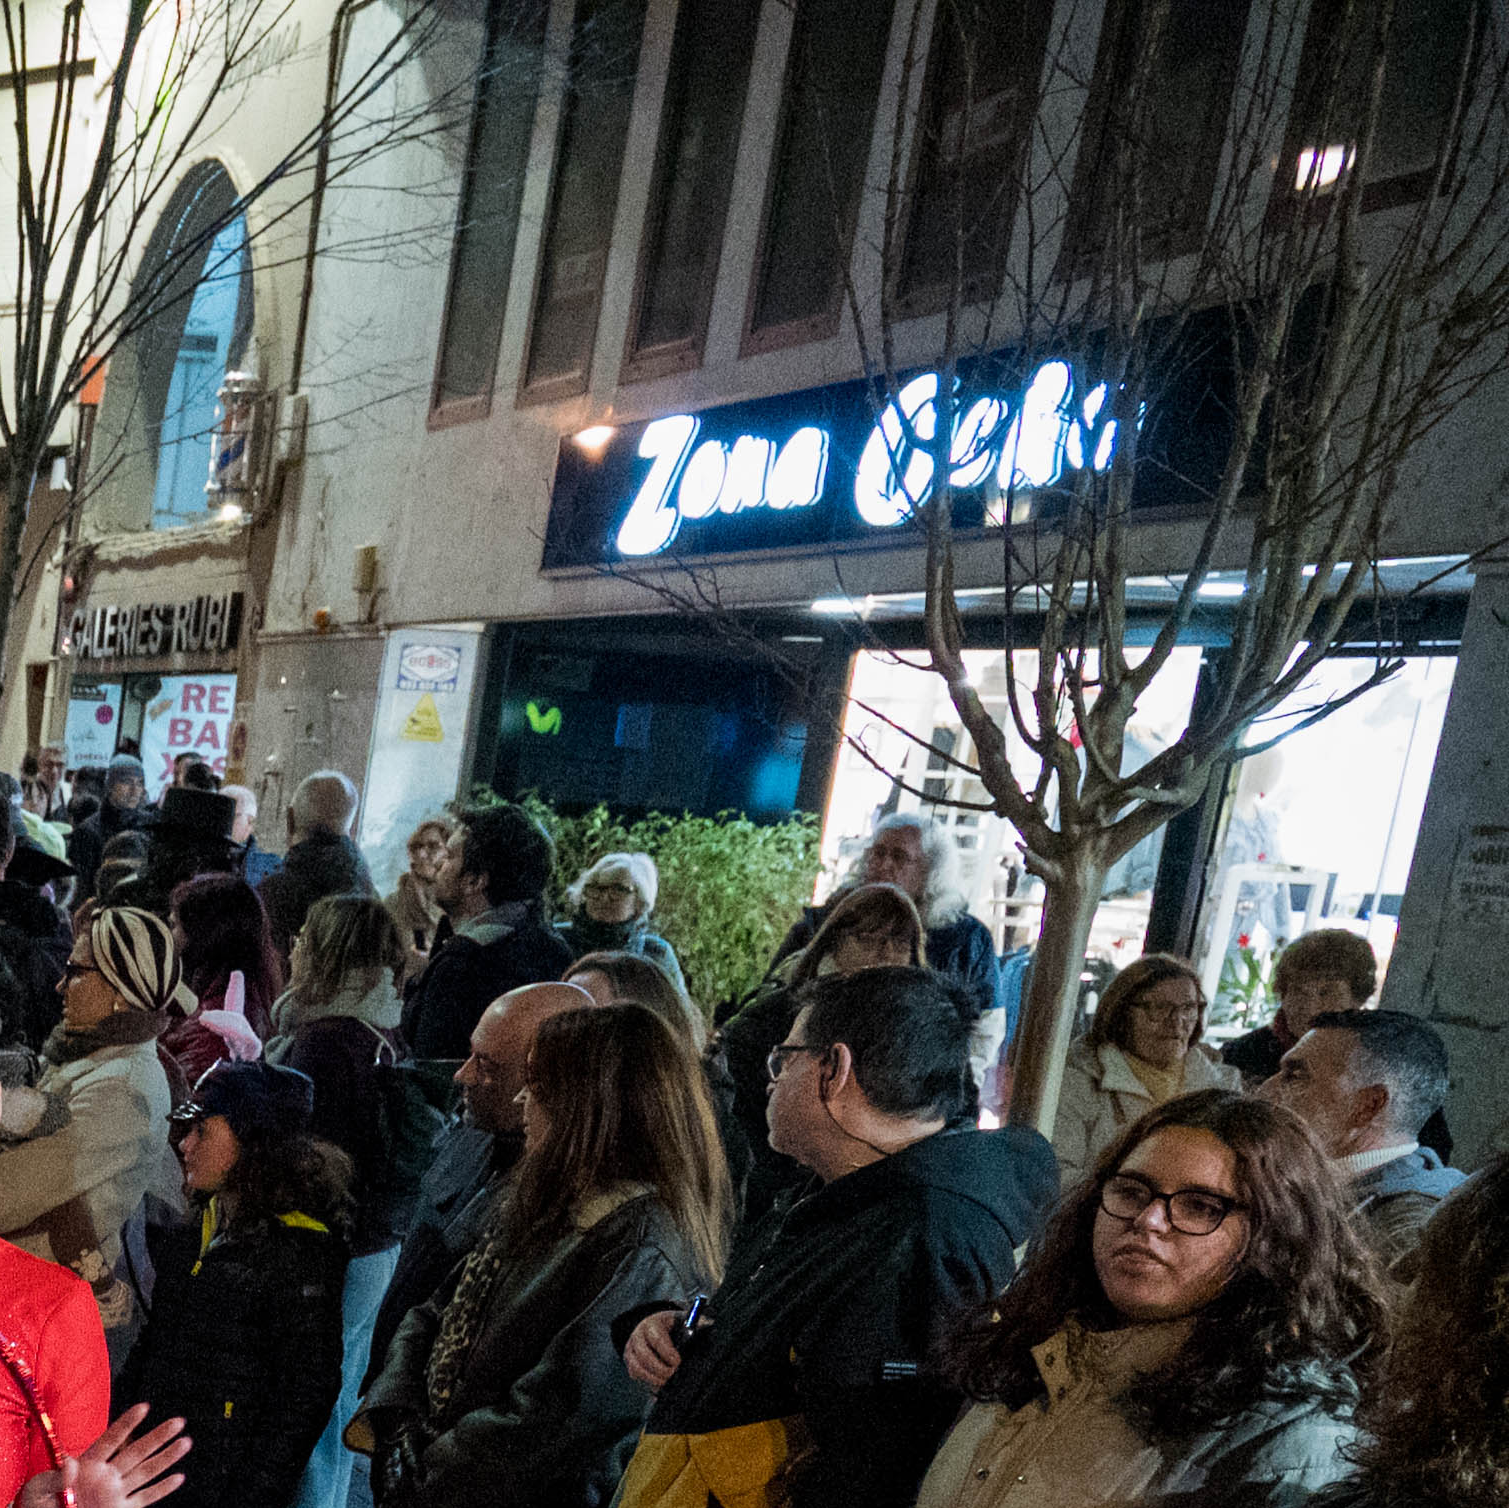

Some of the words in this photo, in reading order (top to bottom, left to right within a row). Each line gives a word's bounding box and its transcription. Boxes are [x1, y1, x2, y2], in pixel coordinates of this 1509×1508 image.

[617, 414, 830, 556] Zona
[70, 604, 164, 658] GALERIES
[172, 596, 229, 650] RUBI
[181, 683, 230, 714] RE
